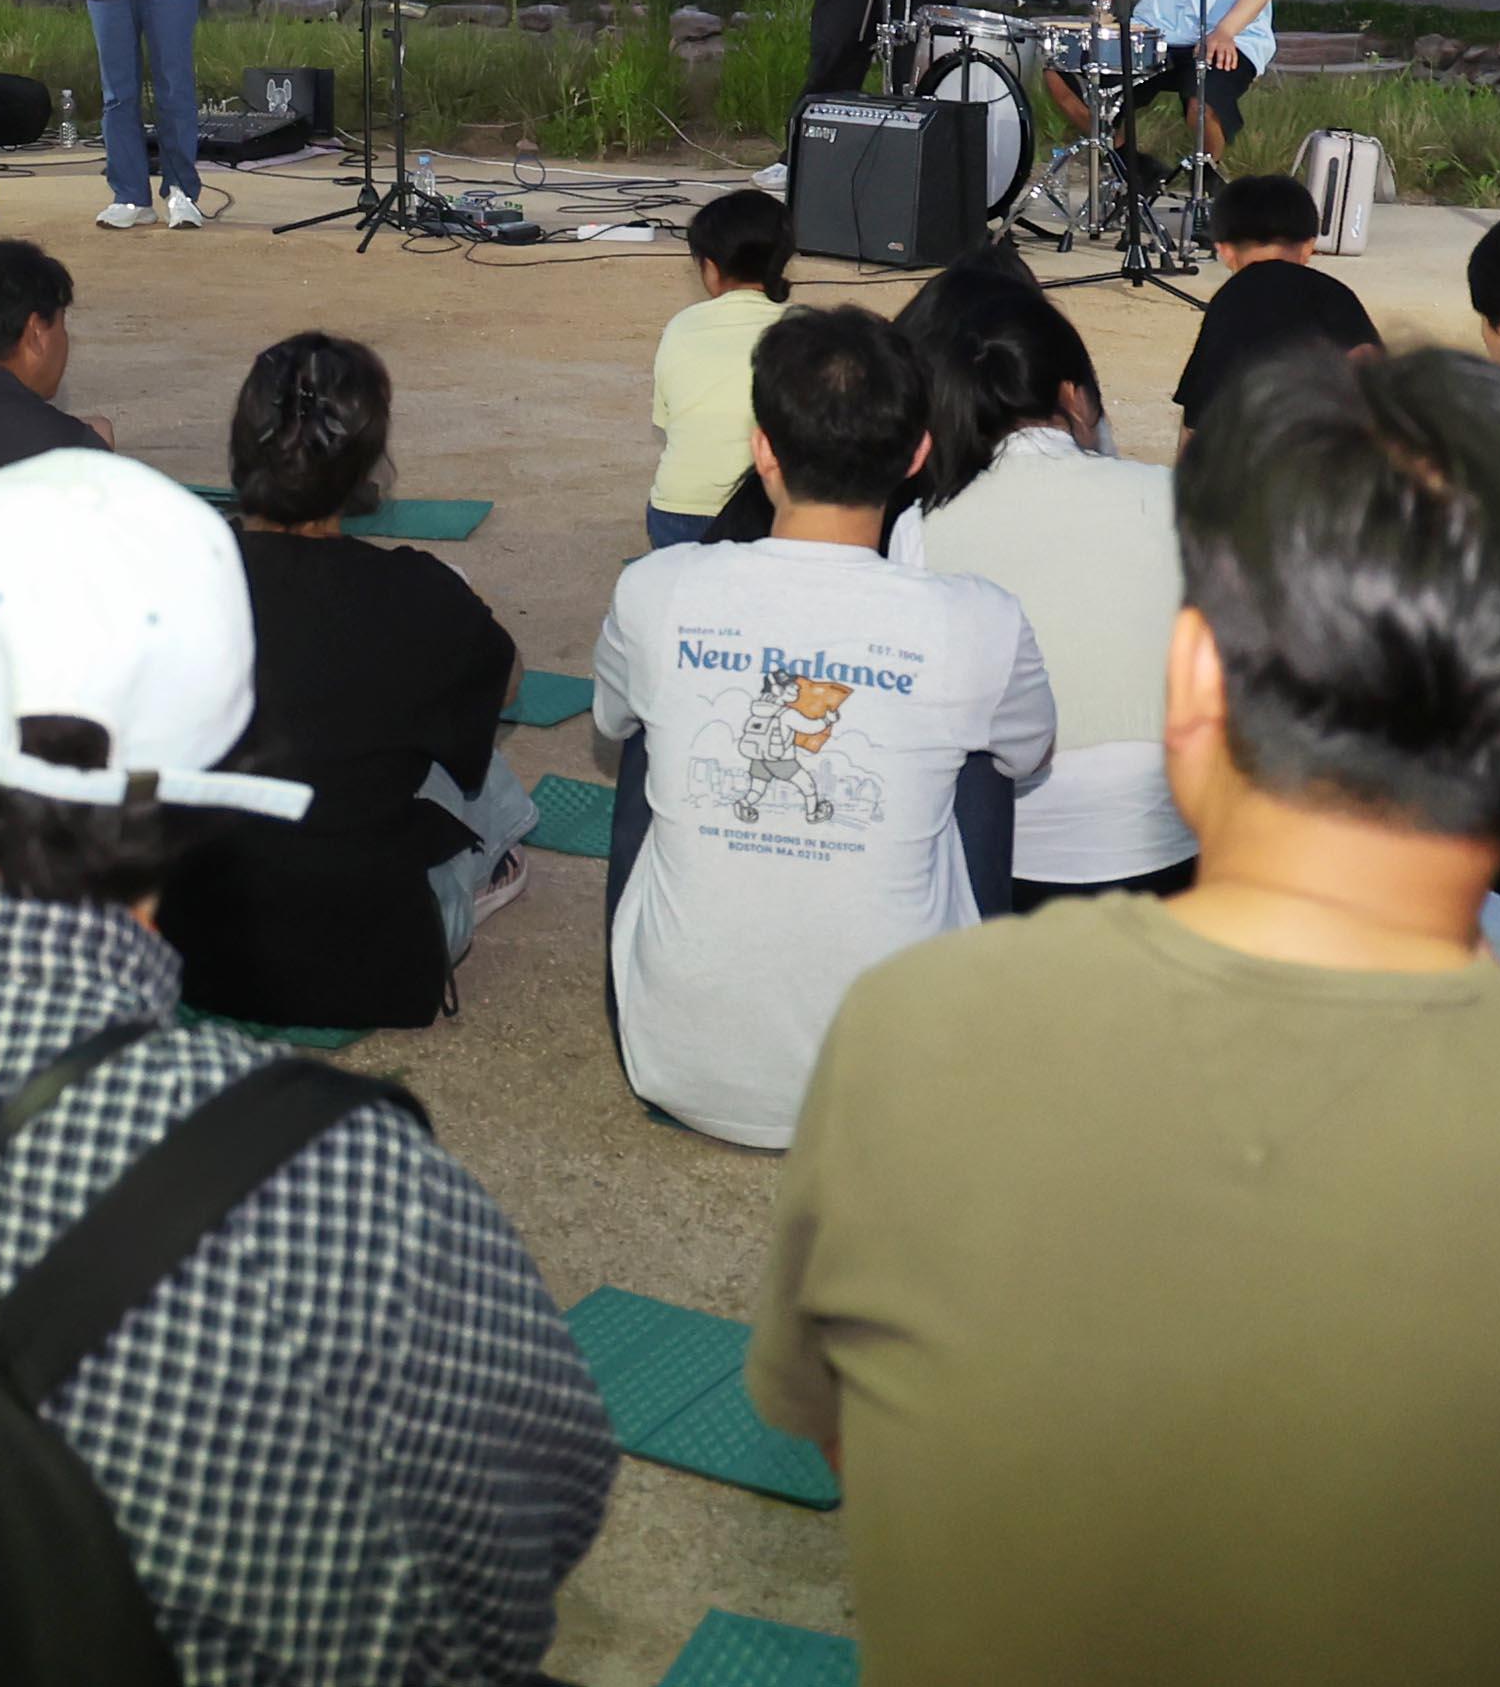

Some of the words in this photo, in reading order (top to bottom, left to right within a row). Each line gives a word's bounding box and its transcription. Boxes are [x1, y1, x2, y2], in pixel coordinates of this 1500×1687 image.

[677, 640, 752, 672] New
[759, 646, 915, 696] Balance
[728, 841, 774, 855] BOSTON
[819, 840, 867, 853] BOSTON
